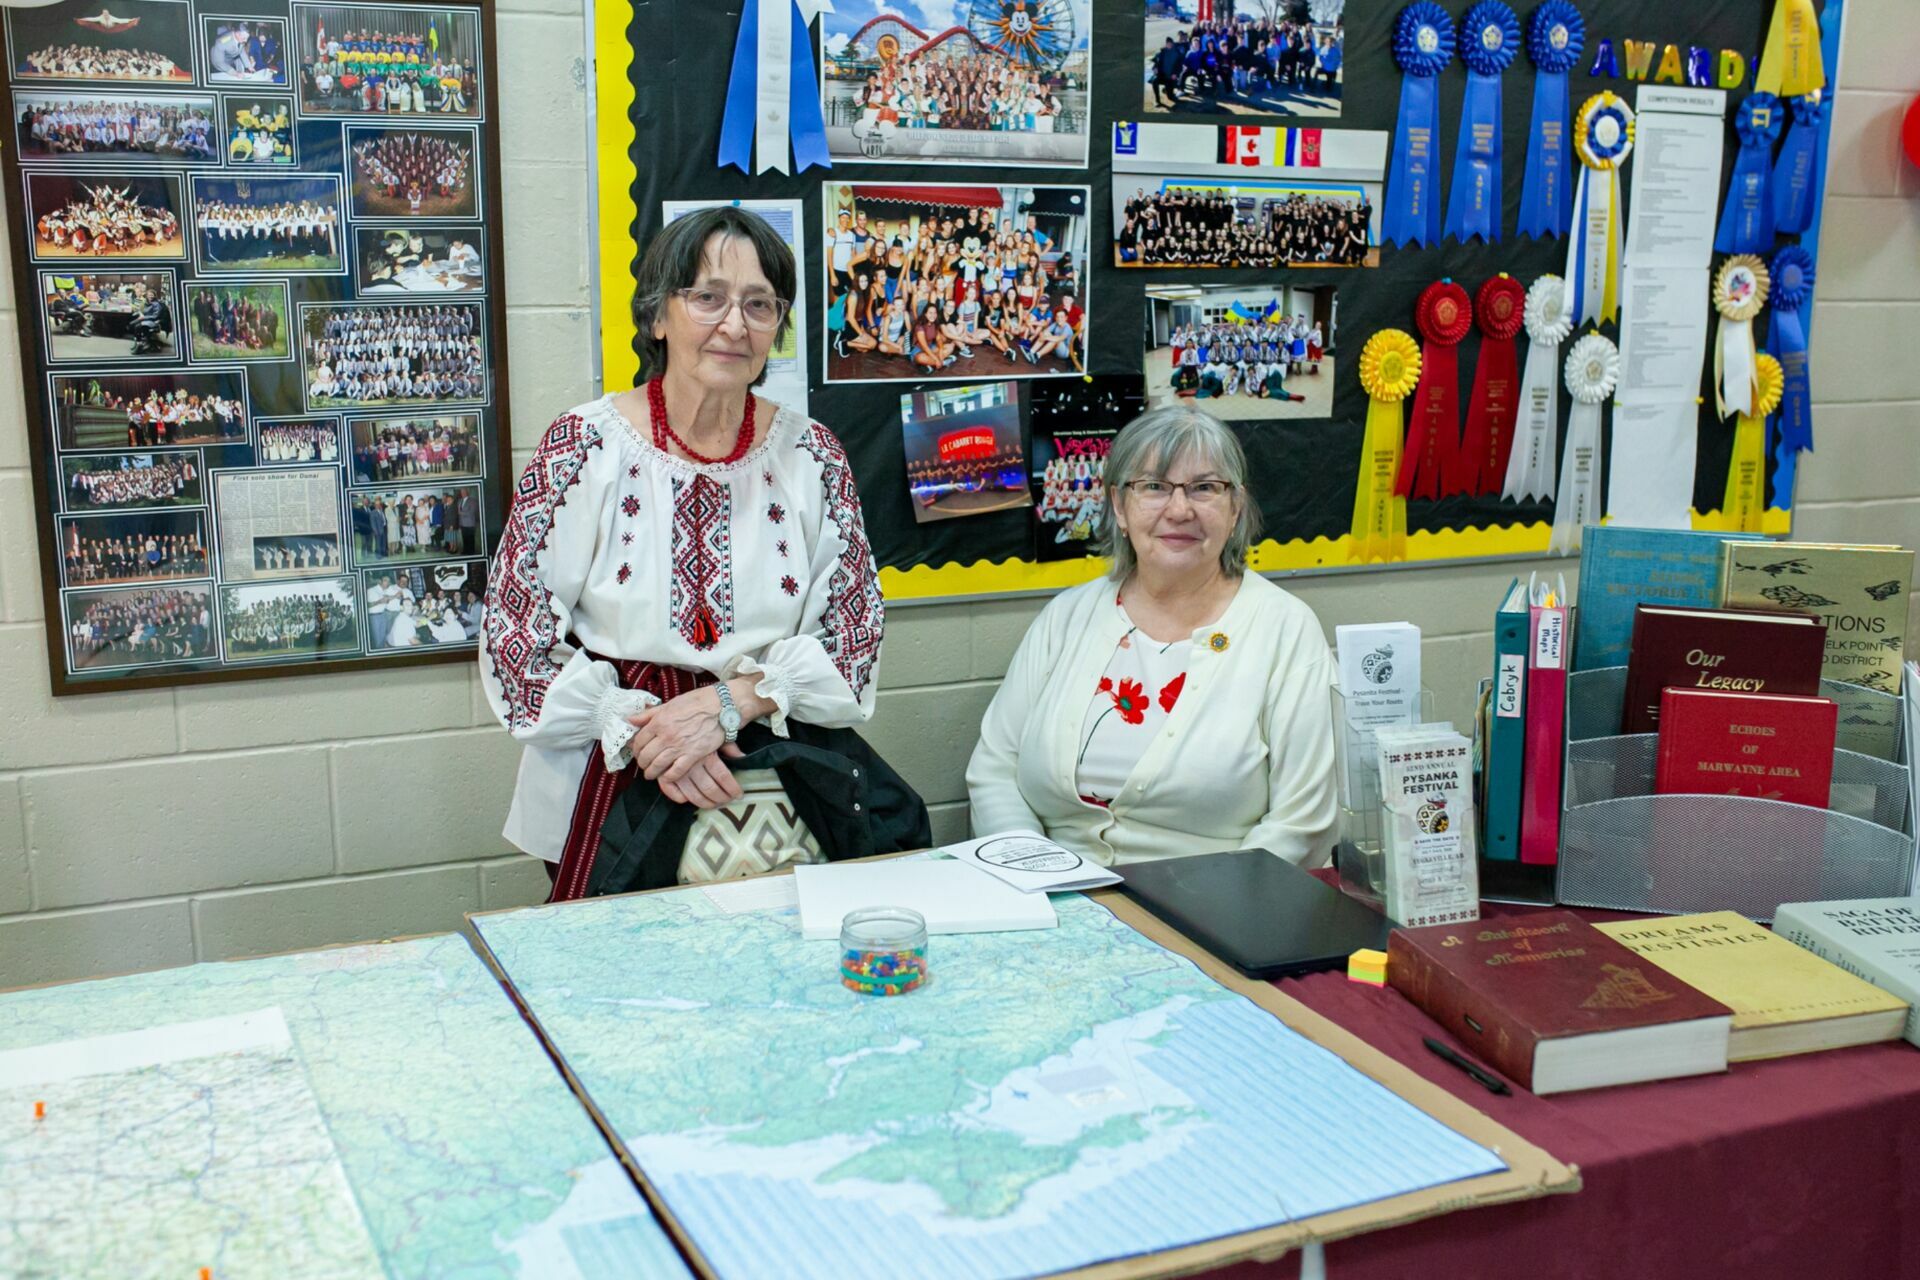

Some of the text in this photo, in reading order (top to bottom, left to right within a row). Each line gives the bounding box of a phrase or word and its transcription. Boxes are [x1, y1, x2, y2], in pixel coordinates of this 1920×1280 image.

[1589, 38, 1759, 92] AWARD
[949, 438, 974, 452] CABARET
[1540, 628, 1550, 654] Maps
[1551, 617, 1561, 658] Historical
[1826, 640, 1885, 652] ELK POINT
[1686, 649, 1725, 667] Our
[1832, 655, 1884, 666] DISTRICT
[1500, 665, 1519, 712] Cebryk
[1696, 671, 1765, 693] Legacy
[1729, 724, 1776, 736] ECHOES
[1742, 745, 1759, 754] OF
[1697, 762, 1801, 777] MARWAYNE AREA
[1402, 771, 1458, 785] PYSANKA
[1403, 781, 1459, 794] FESTIVAL
[1823, 907, 1912, 919] SAGA OF
[1620, 923, 1729, 941] DREAMS
[1513, 938, 1532, 951] of
[1485, 948, 1586, 966] Memories
